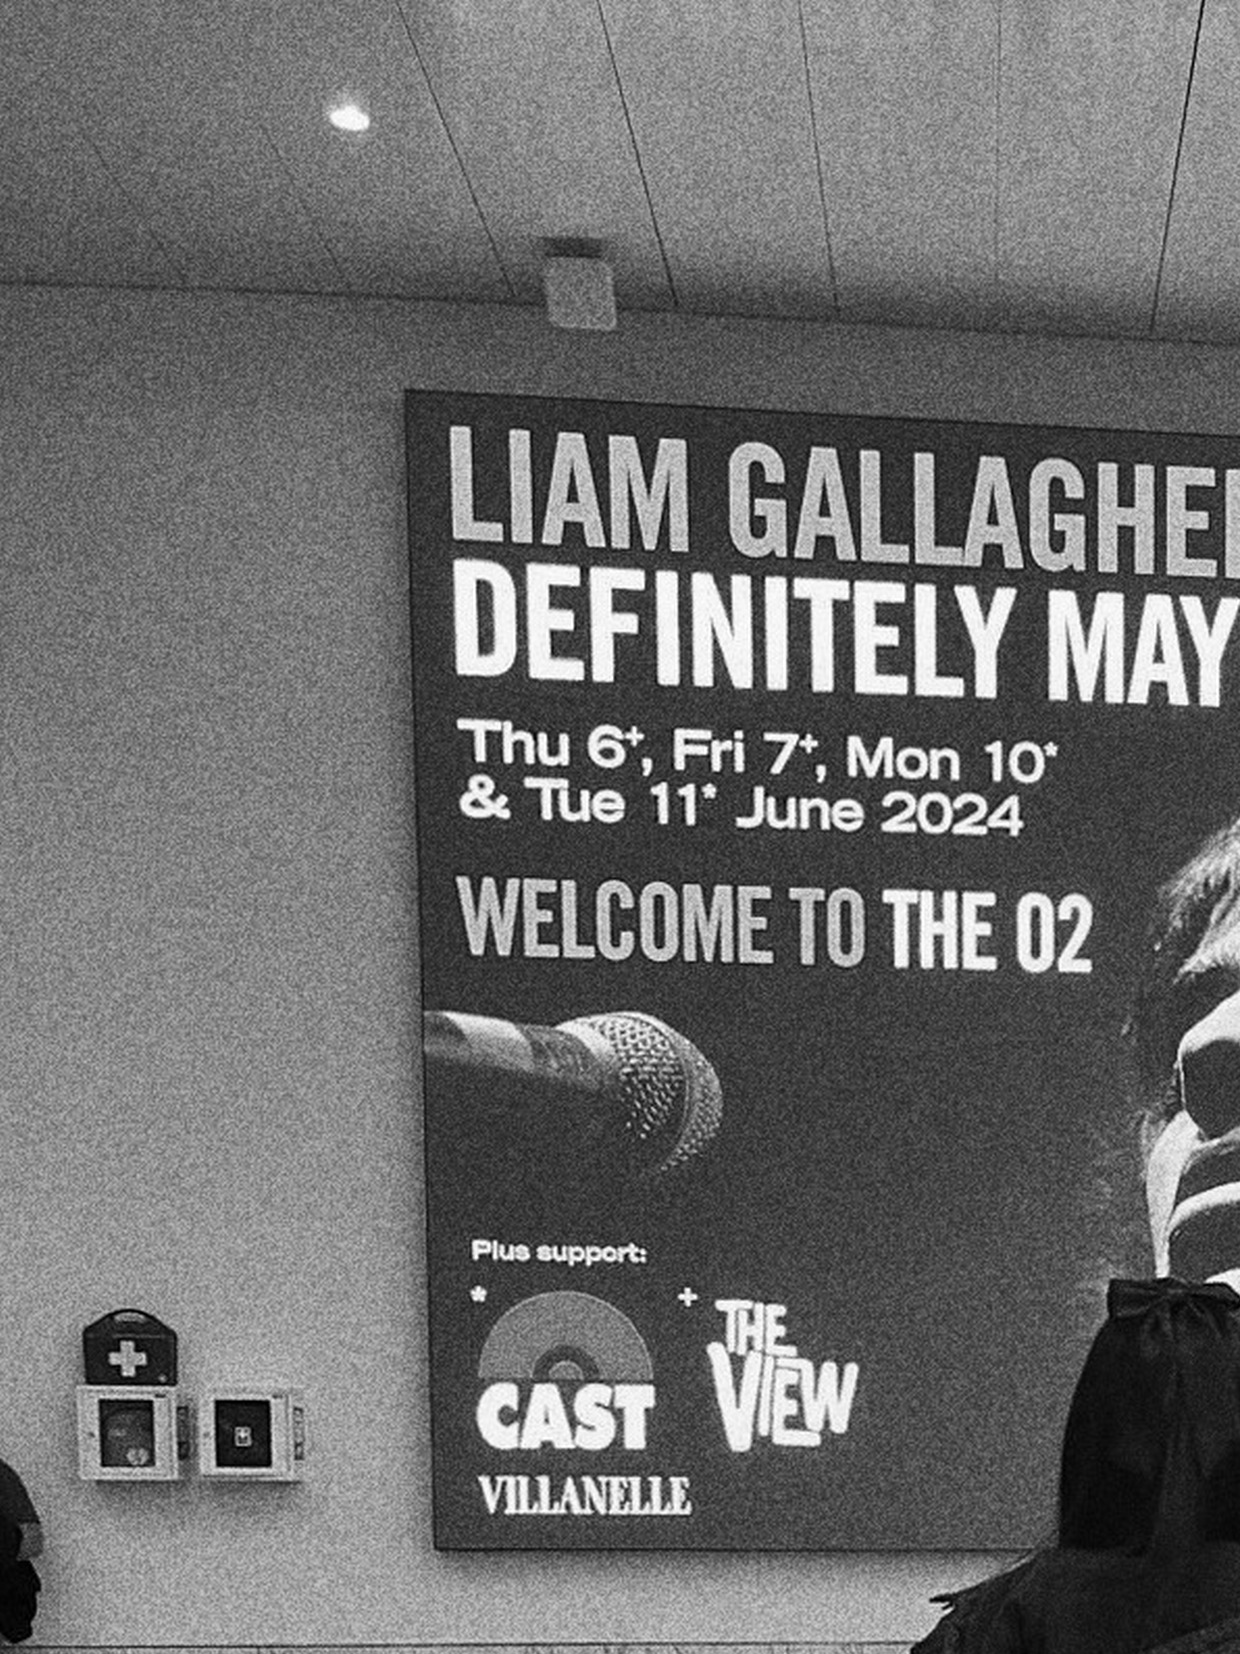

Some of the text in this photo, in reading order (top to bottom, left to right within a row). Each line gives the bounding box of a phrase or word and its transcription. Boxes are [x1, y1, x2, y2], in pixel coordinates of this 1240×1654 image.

[449, 425, 690, 553] LIAM
[453, 558, 1016, 699] DEFINITELY
[456, 717, 570, 767] Thu
[673, 728, 745, 773] Fri
[846, 735, 961, 781] Mon
[459, 773, 511, 820] &
[523, 776, 626, 823] Tue
[735, 785, 866, 833] June
[880, 790, 1025, 837] 2024
[456, 876, 772, 964] WELCOME
[789, 887, 865, 968] TO
[882, 889, 998, 971] THE
[471, 1239, 647, 1266] Plus support:
[714, 1299, 799, 1357] THE
[476, 1382, 656, 1450] CAST
[706, 1341, 860, 1453] VIEW
[477, 1475, 693, 1516] VILLANELLE
